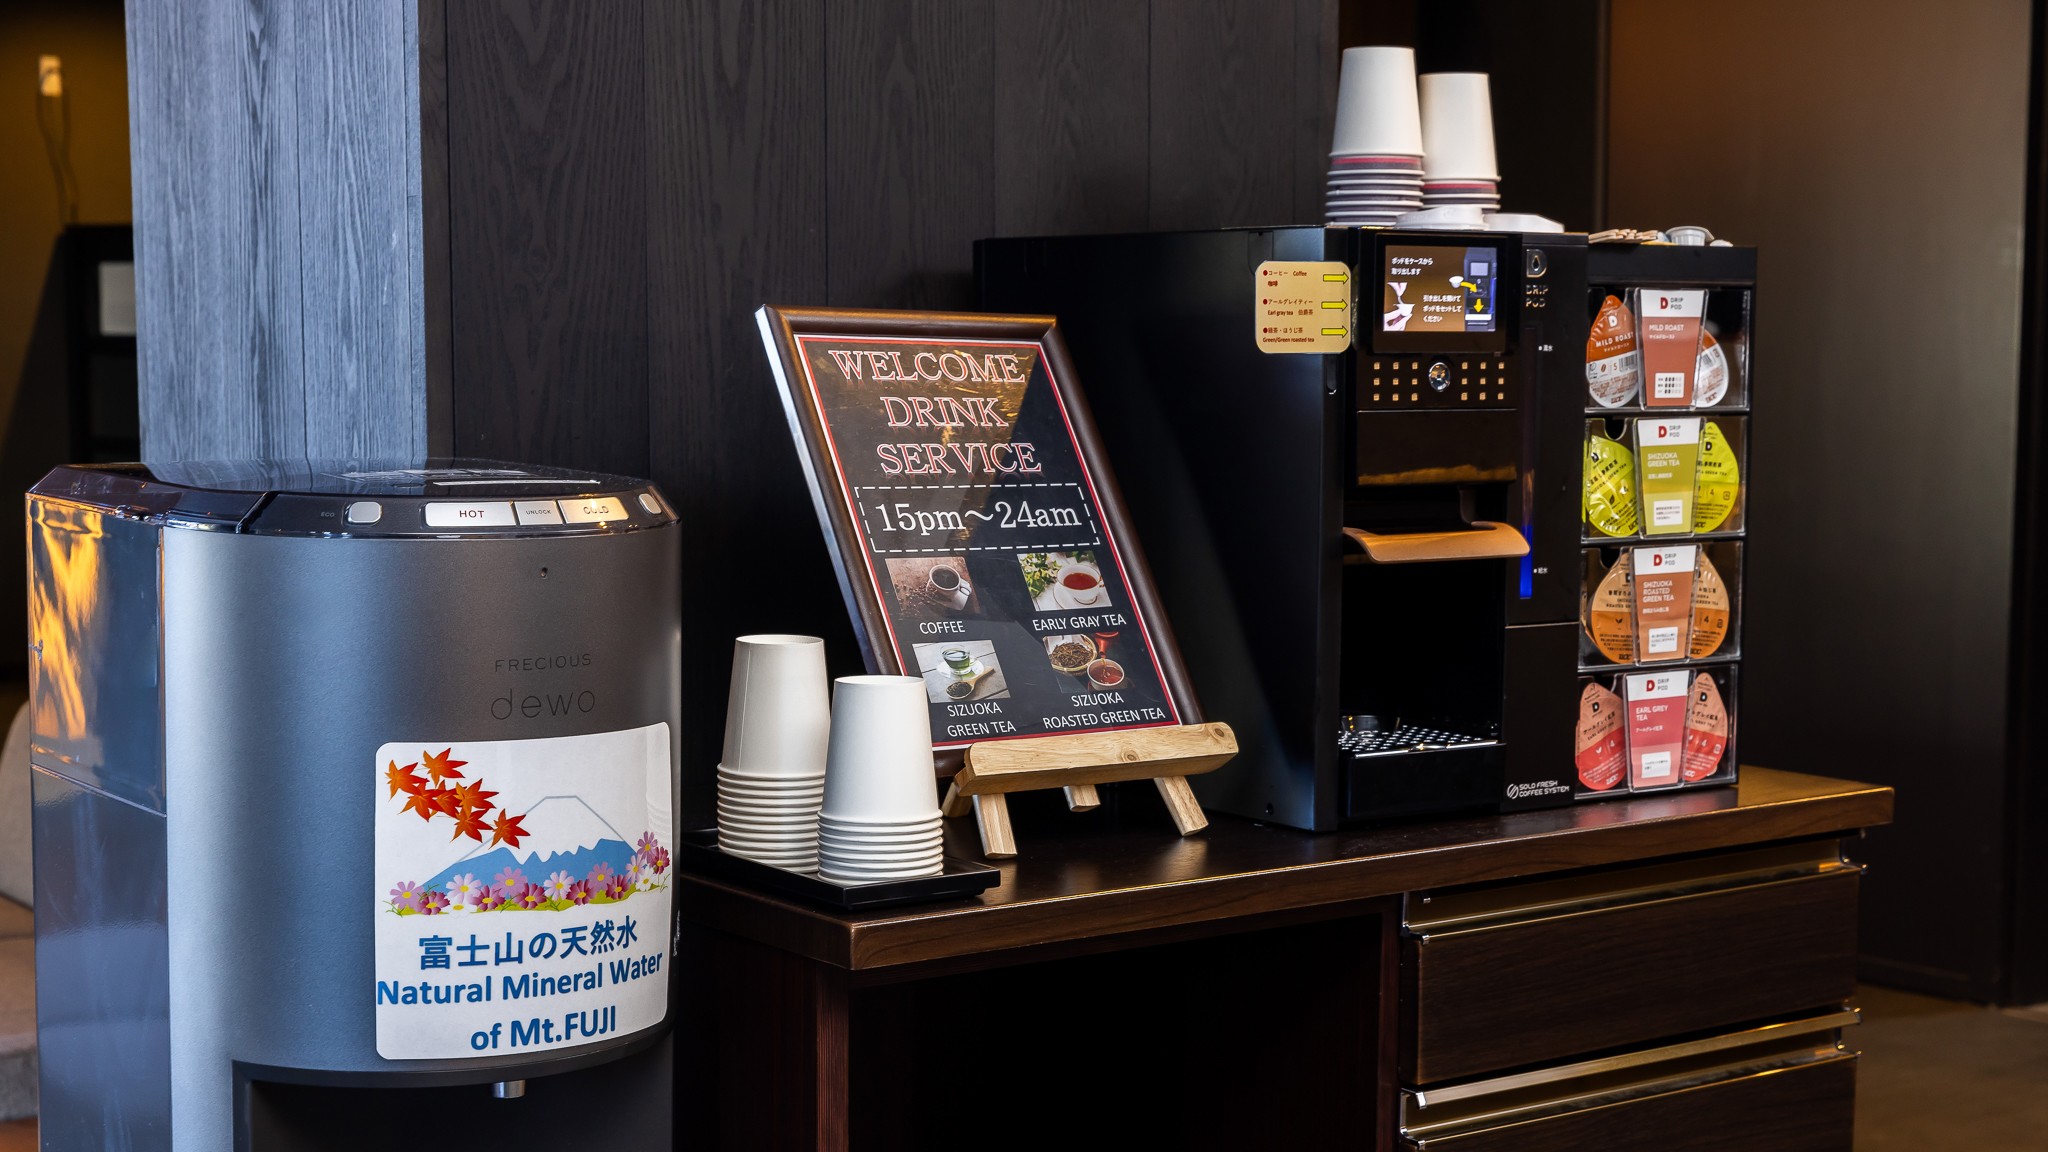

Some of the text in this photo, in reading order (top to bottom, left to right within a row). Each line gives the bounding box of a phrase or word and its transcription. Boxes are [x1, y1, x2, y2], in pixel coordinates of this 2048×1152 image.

[1595, 331, 1634, 348] MILD ROAST
[828, 350, 1026, 383] WELCOME
[880, 396, 1010, 427] DRINK
[876, 442, 1042, 474] SERVICE
[1647, 451, 1677, 460] SHIZUOKA
[1647, 459, 1680, 468] GREEN TEA
[459, 509, 485, 519] HOT
[525, 508, 551, 516] UNLOCK
[1642, 587, 1670, 595] ROASTED
[1643, 580, 1673, 589] SHIZUOKA
[1642, 594, 1675, 603] GREEN TEA
[919, 620, 966, 635] COFFEE
[1032, 613, 1127, 632] EARLY GRAY TEA
[494, 653, 592, 673] FRECIOUS
[490, 689, 596, 721] dewo
[1071, 691, 1124, 707] SIZUOKA
[947, 701, 1003, 717] SIZUOKA
[1635, 704, 1668, 715] EARL GREY
[1042, 707, 1166, 729] ROASTED GREEN TEA
[947, 720, 1017, 738] GREEN TEA
[1519, 780, 1558, 790] SOLO FRESH
[1519, 785, 1570, 797] COFFEE SYSTEM
[418, 915, 638, 970] 富士山の天然水
[377, 951, 663, 1005] Natural Mineral Water
[470, 1005, 616, 1051] of Mt.FUJI
